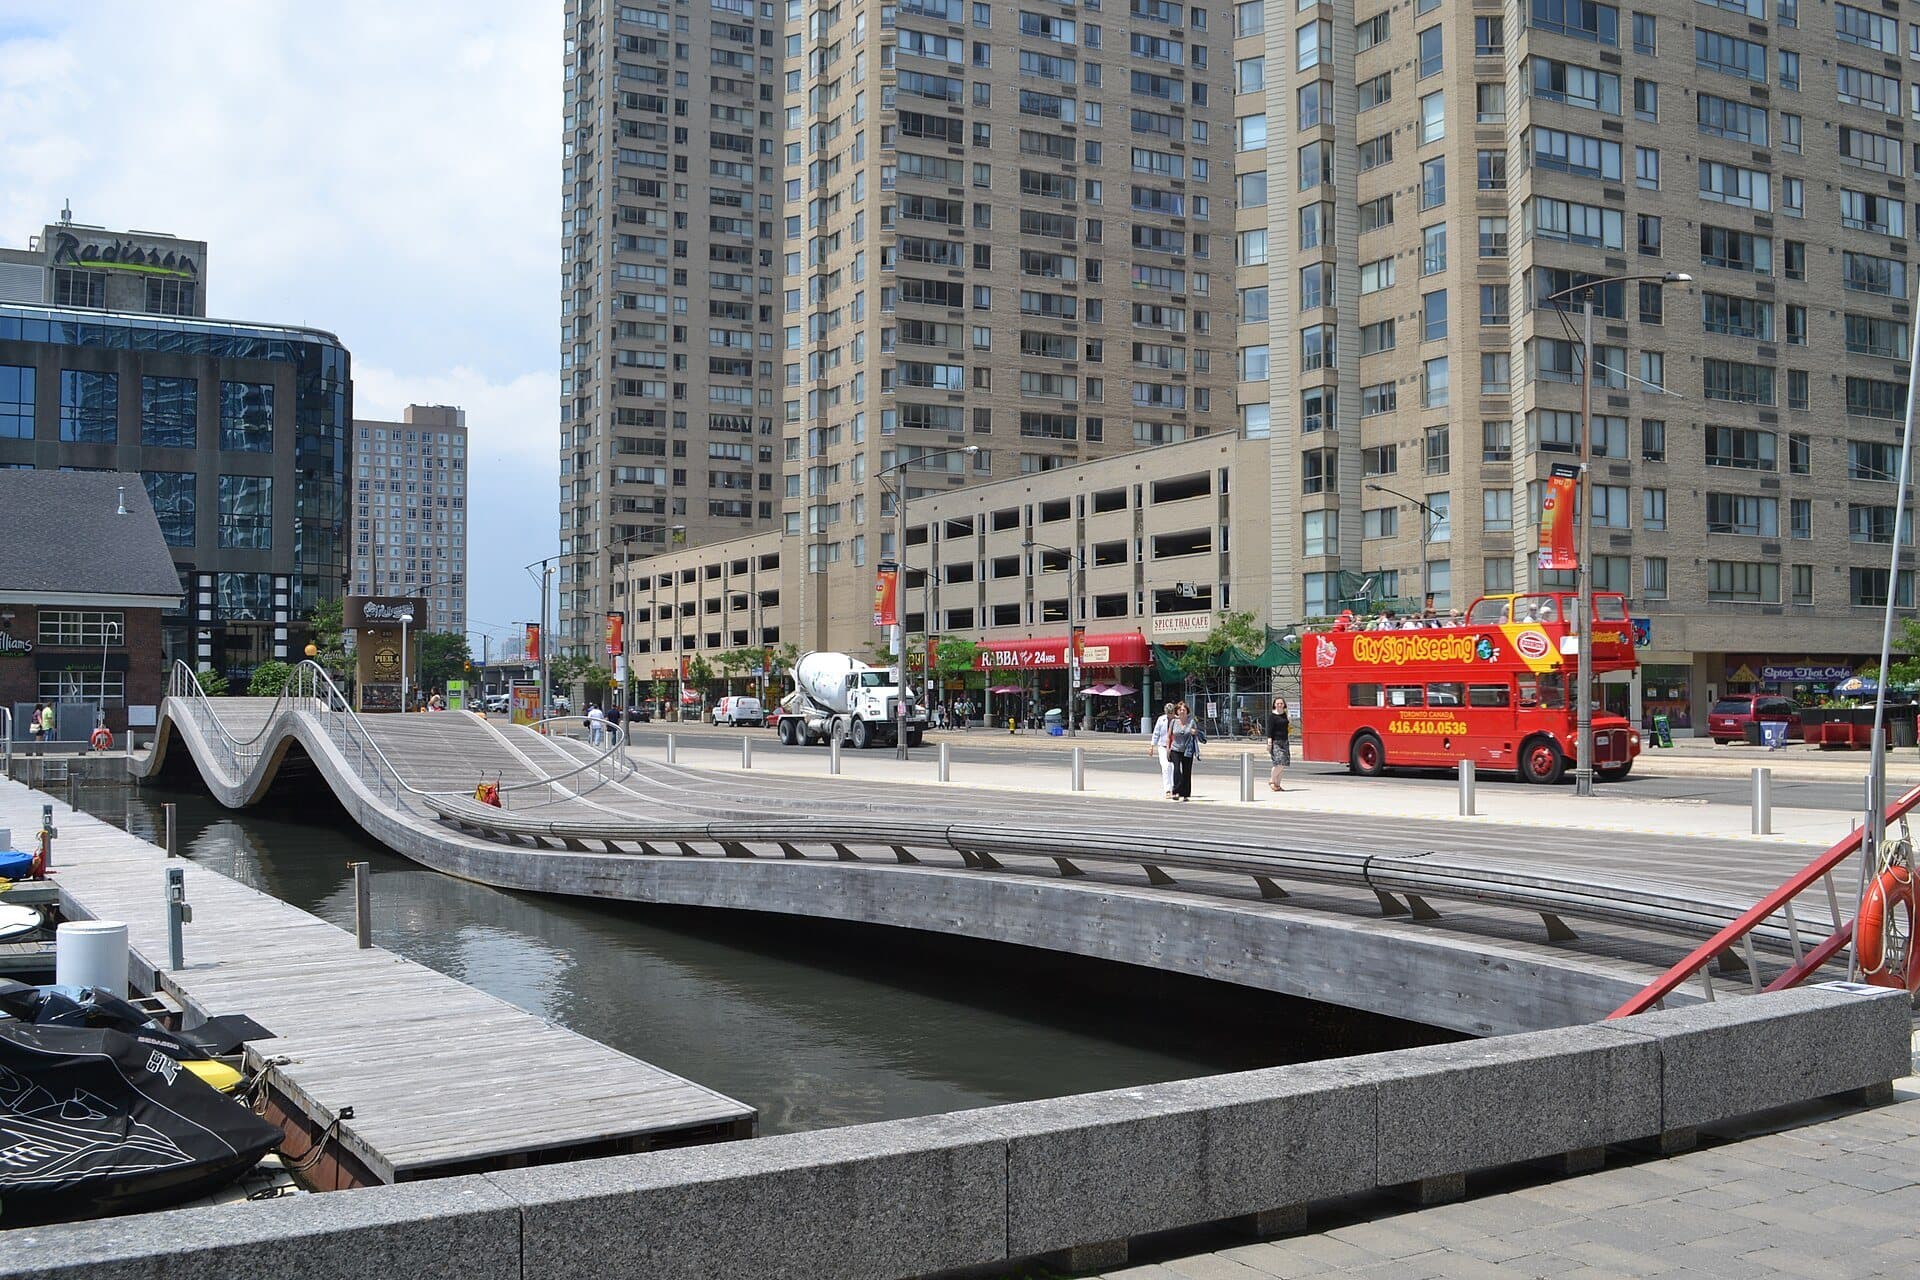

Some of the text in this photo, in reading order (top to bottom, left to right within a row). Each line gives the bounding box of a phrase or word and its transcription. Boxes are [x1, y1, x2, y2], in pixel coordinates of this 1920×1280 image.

[53, 232, 198, 273] Radisson
[1154, 616, 1209, 628] SPICE THAI CAFE
[1353, 634, 1475, 666] CitySightseeing
[1764, 667, 1850, 680] Spice Thai Cafe
[1399, 711, 1455, 720] TORONTO CANADA
[1389, 720, 1467, 735] 416.410.0536
